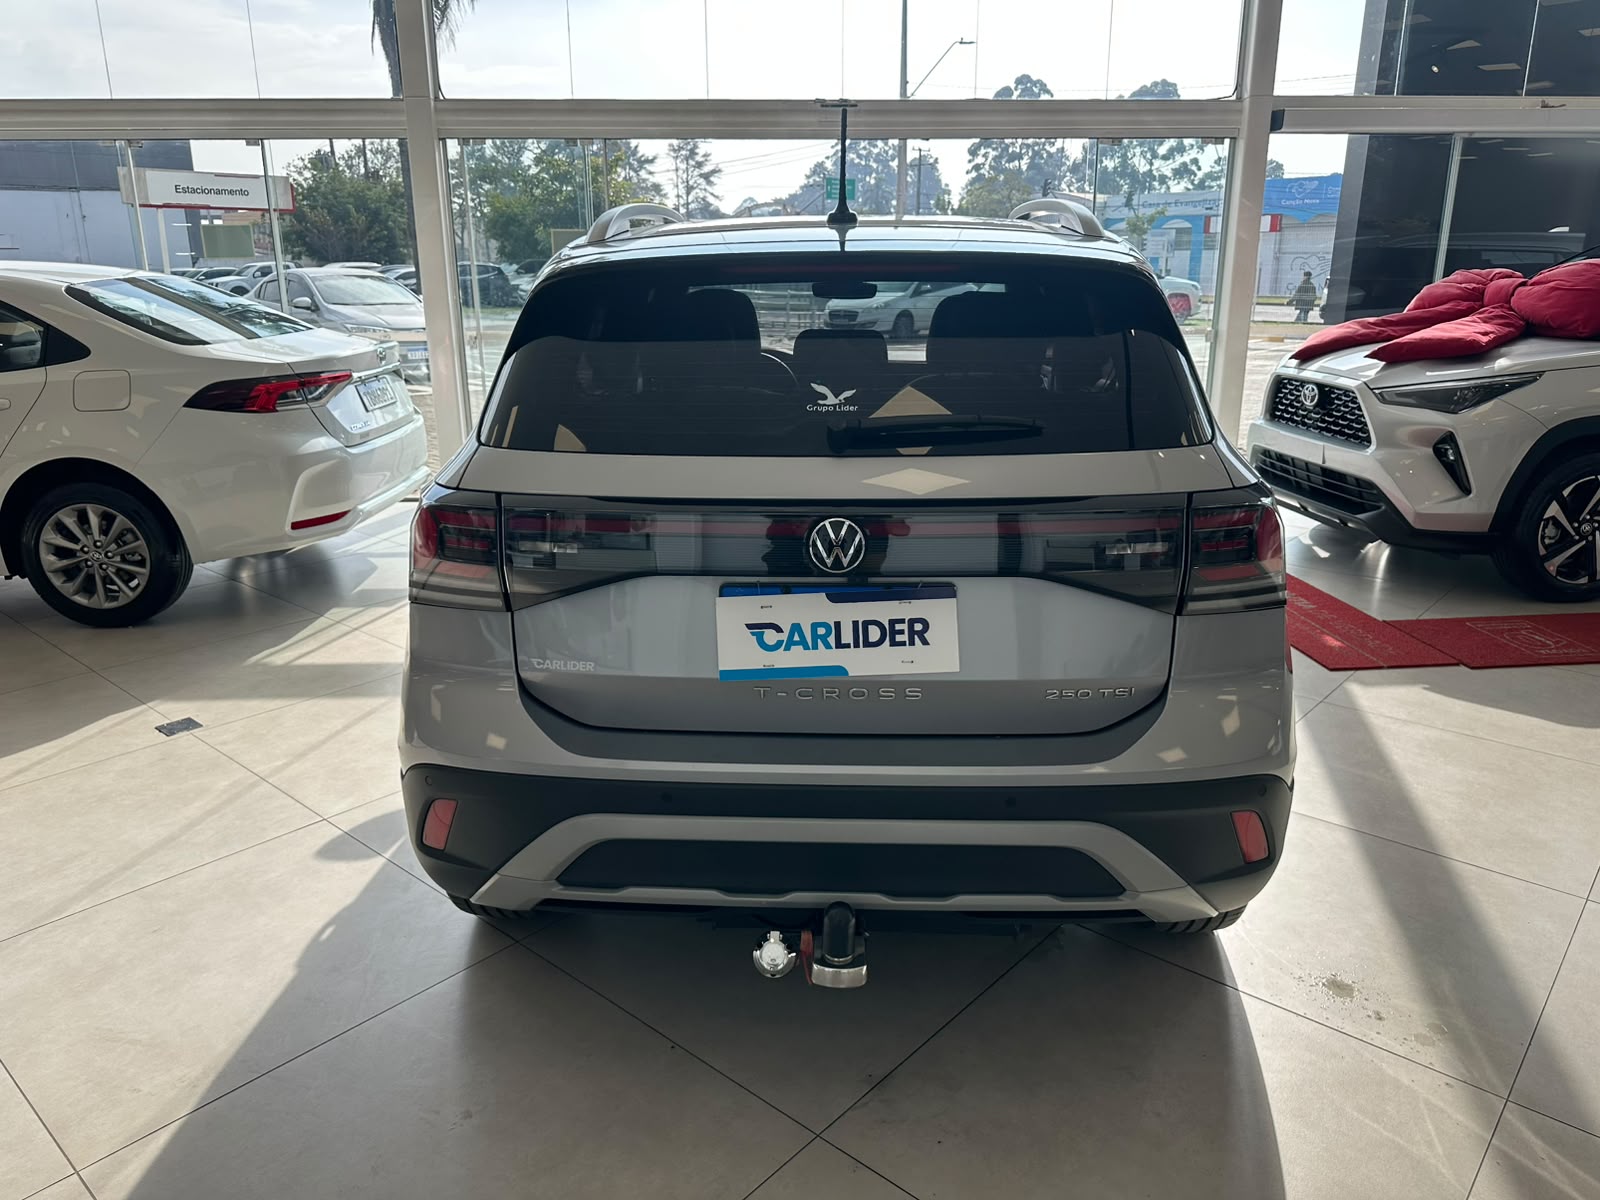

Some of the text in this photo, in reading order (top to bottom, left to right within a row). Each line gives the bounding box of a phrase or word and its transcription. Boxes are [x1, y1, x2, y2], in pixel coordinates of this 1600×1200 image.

[174, 184, 250, 197] Estacionamento
[806, 404, 834, 412] Grupo
[744, 617, 931, 653] CARLIDER
[529, 658, 595, 672] CARLIDER
[753, 687, 923, 701] T-CROSS
[1045, 686, 1136, 700] 250 TSI
